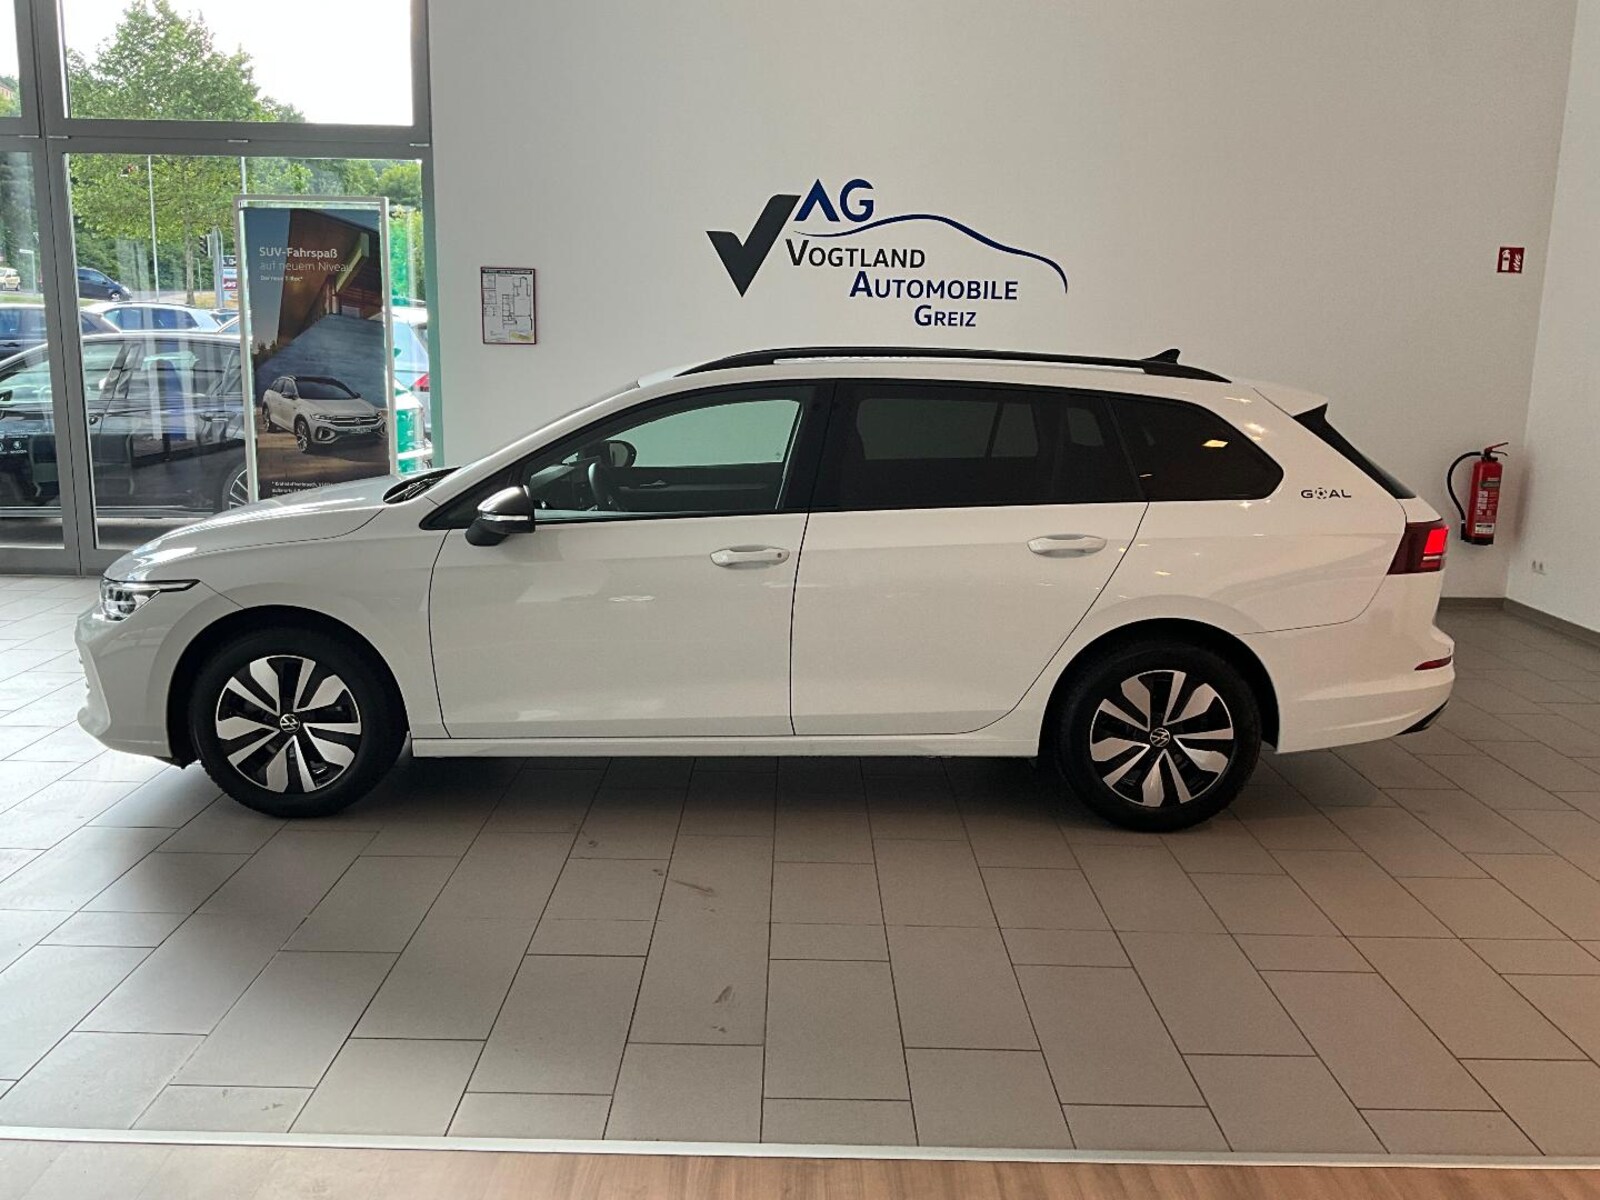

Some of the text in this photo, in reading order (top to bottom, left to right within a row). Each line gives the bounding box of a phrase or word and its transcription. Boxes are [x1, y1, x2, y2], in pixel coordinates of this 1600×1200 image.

[259, 247, 338, 260] SUV-Fahrspaß
[785, 238, 926, 268] VOGTLAND
[279, 262, 315, 271] neuem
[849, 270, 1019, 300] AUTOMOBILE
[914, 304, 977, 327] GREIZ
